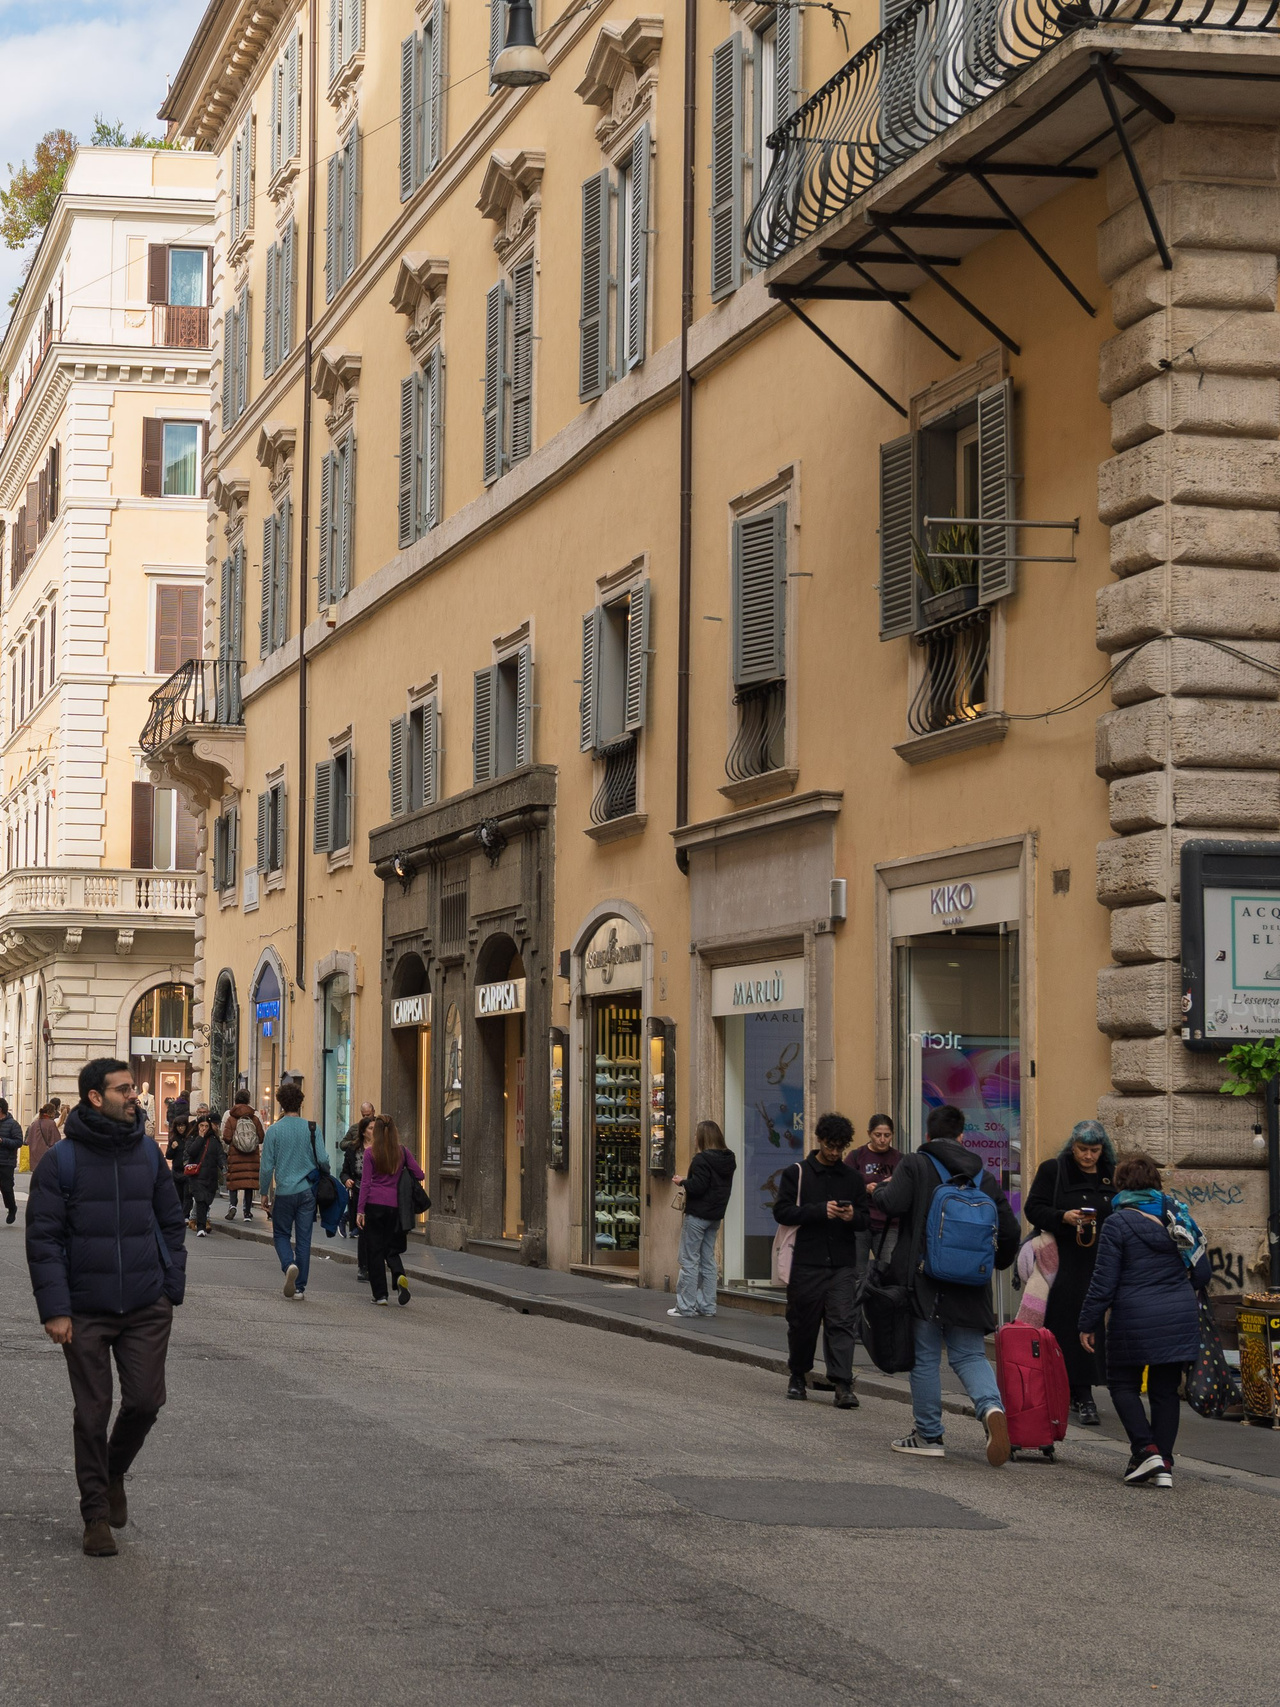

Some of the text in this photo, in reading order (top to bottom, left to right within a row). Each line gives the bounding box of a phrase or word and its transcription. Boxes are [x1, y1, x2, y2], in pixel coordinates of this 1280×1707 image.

[930, 882, 974, 914] KIKO
[1252, 933, 1280, 945] EL
[732, 970, 781, 1006] MARLÙ
[479, 983, 516, 1014] CARPISA
[1233, 993, 1280, 1009] L'essenza
[393, 998, 423, 1025] CARPISA
[1252, 1015, 1265, 1024] Via
[983, 1122, 1006, 1132] 30%
[961, 1140, 1008, 1149] OMOZIO
[987, 1157, 1010, 1168] 50%
[1237, 1313, 1267, 1326] CASTAGNA
[1242, 1322, 1262, 1333] CALDE
